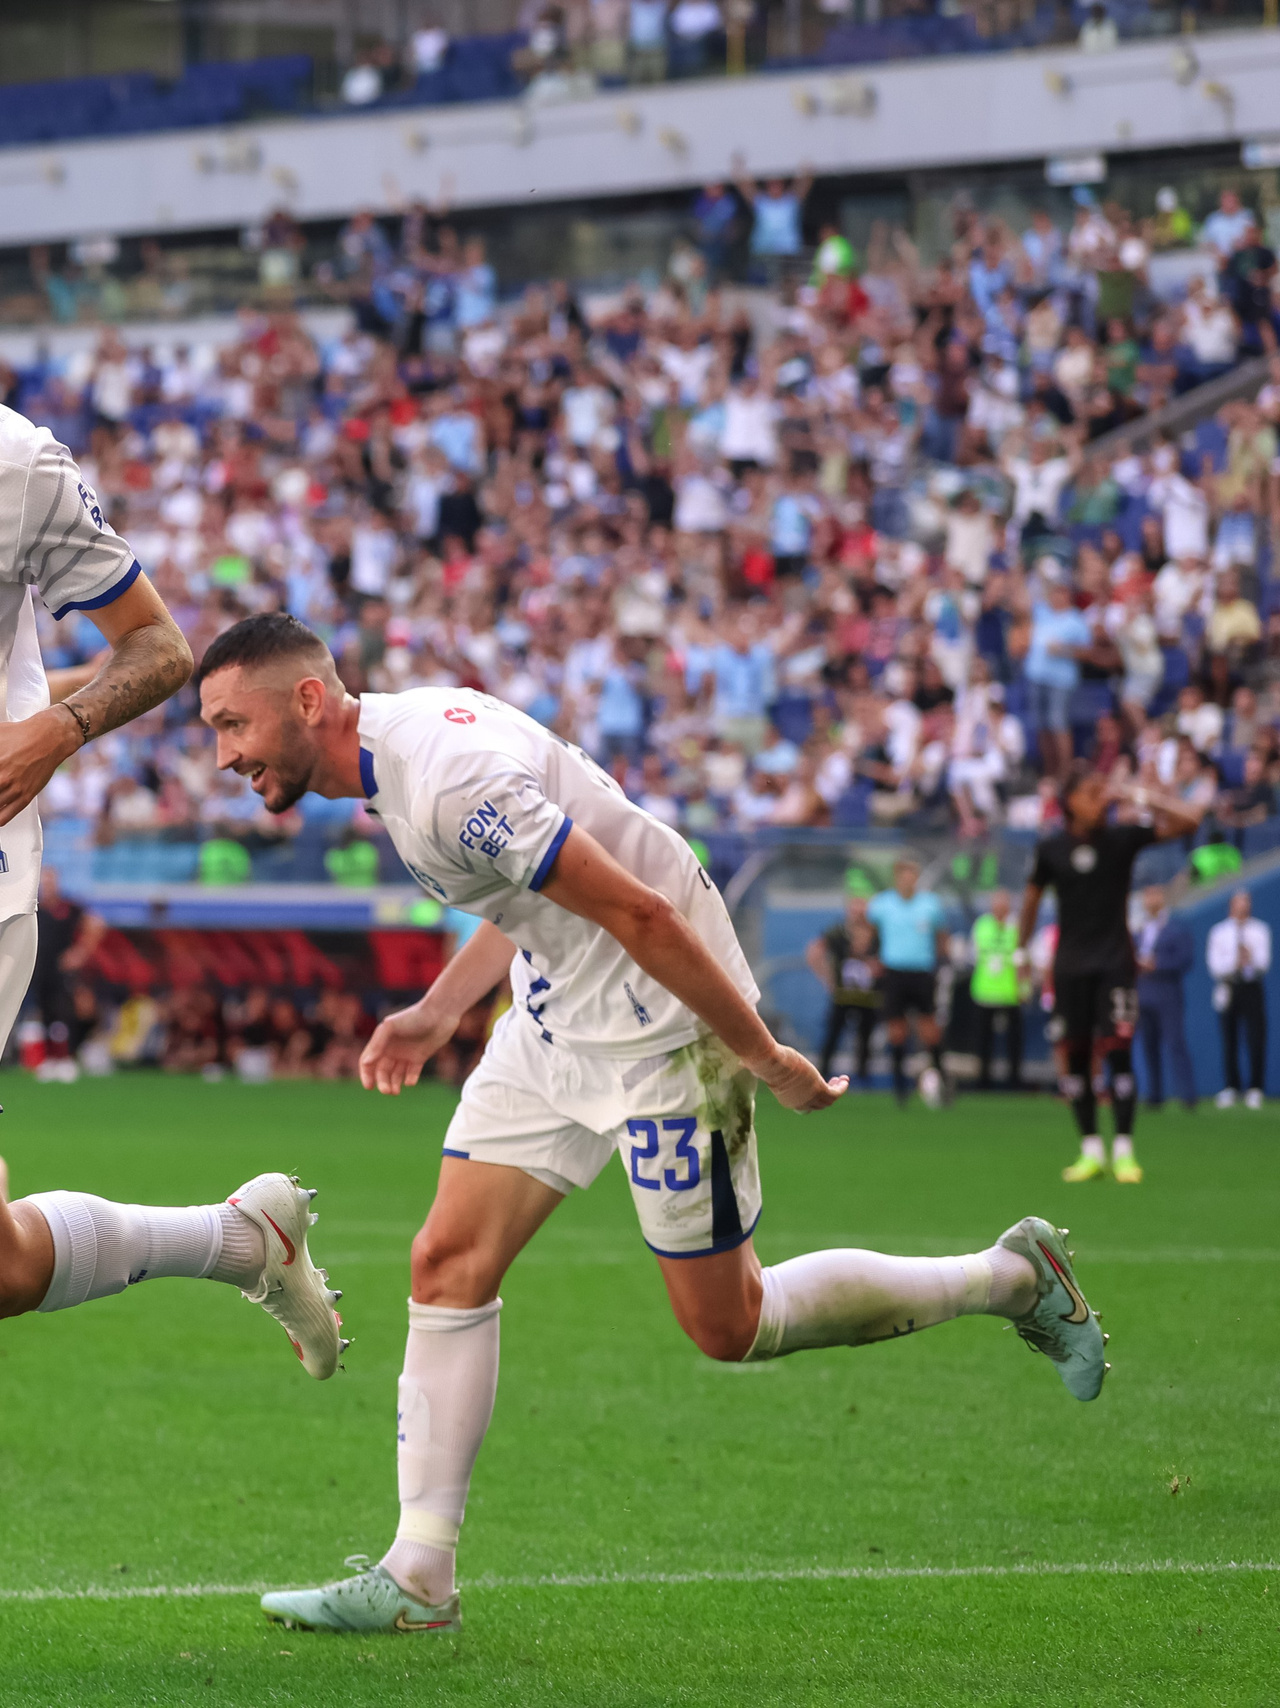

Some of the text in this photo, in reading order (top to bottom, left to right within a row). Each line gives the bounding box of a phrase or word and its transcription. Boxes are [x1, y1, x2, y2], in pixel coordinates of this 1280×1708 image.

[459, 800, 498, 850] FON
[480, 814, 514, 858] BET
[626, 1116, 700, 1191] 23
